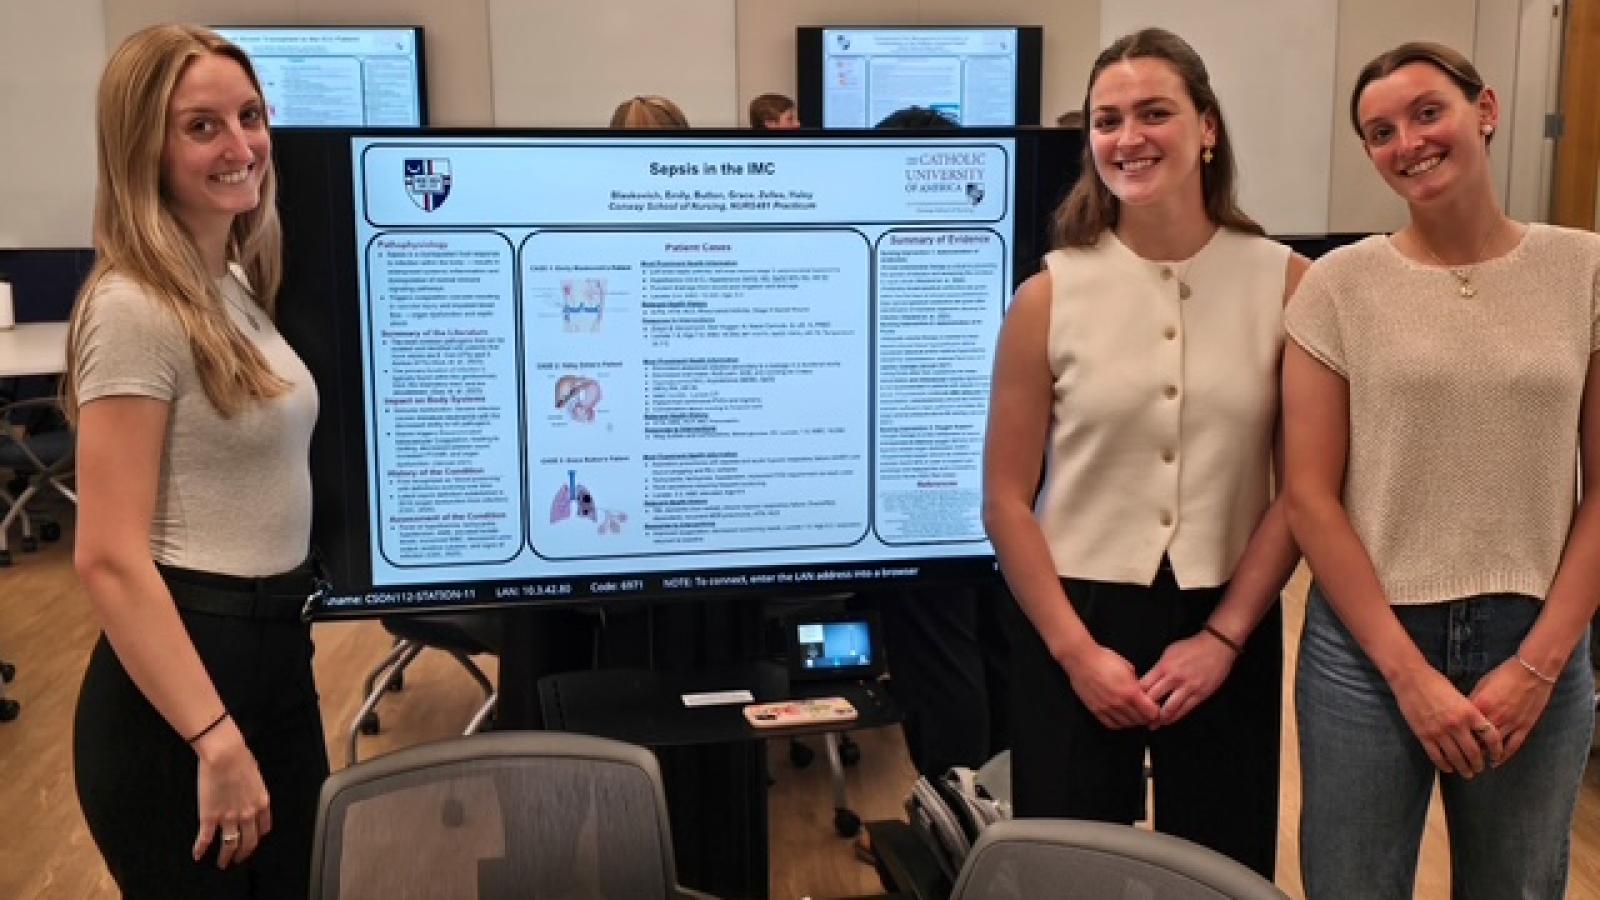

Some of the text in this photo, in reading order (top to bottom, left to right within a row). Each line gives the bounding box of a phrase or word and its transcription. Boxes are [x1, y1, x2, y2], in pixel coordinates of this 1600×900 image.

[919, 152, 986, 166] CATHOLIC
[649, 162, 776, 178] Sepsis in the IMC
[904, 169, 986, 181] UNIVERSITY
[919, 184, 963, 193] AMERICA
[889, 234, 991, 246] Summary of Evidence
[664, 242, 732, 252] Patient Cases
[662, 577, 693, 588] NOTE:
[695, 576, 709, 586] To
[749, 573, 776, 584] enter
[777, 572, 793, 582] the
[590, 581, 617, 593] Code:
